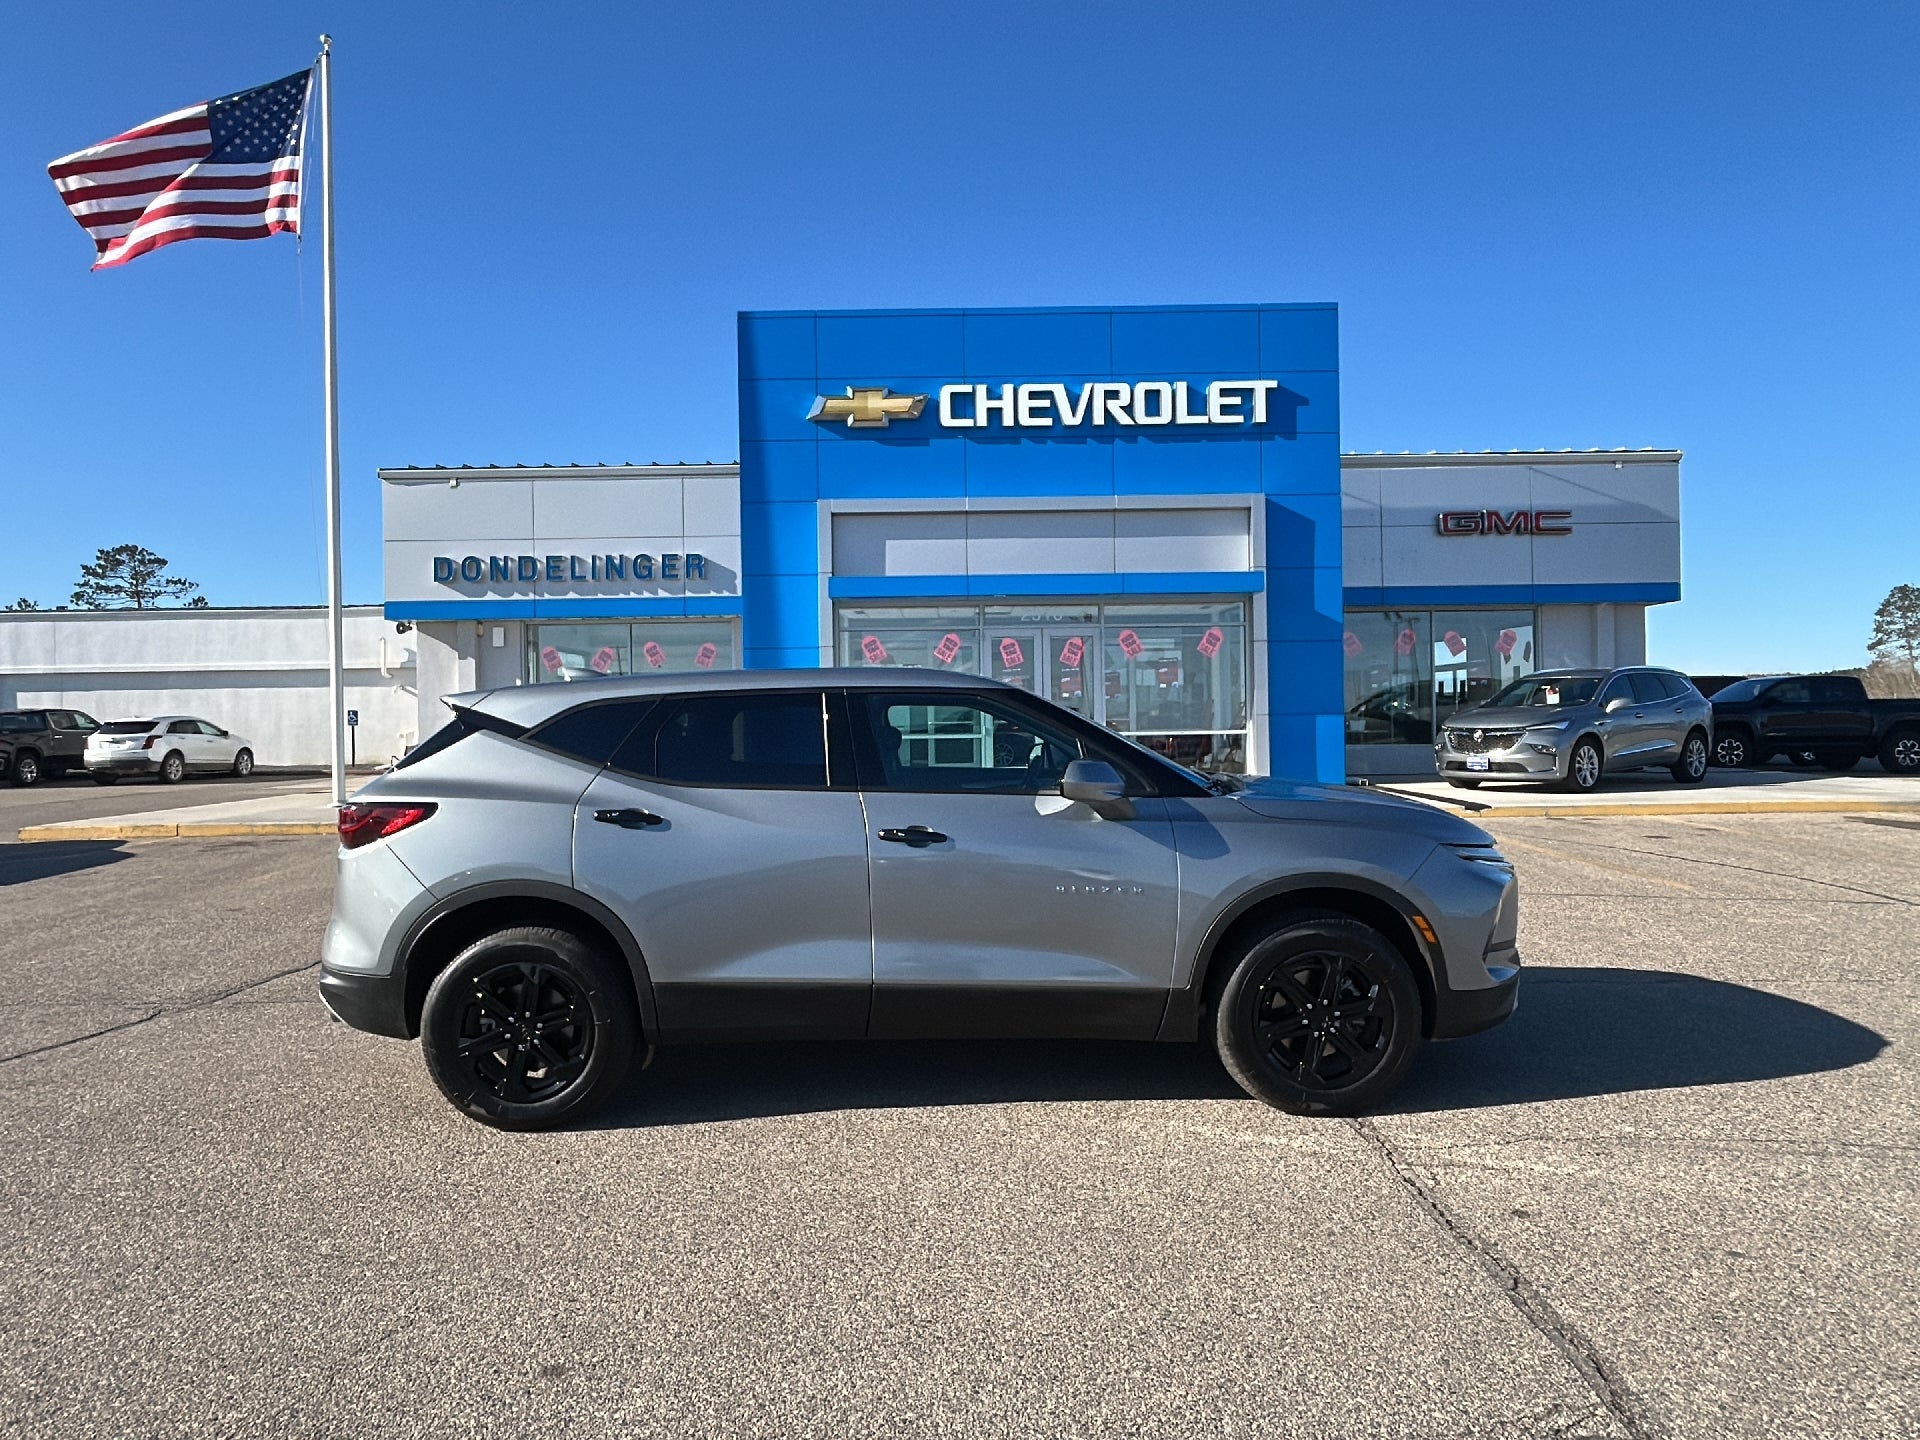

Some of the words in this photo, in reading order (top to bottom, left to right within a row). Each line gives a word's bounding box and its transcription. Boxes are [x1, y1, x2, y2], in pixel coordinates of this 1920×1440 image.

[940, 380, 1278, 427] CHEVROLET
[1438, 510, 1573, 535] GMC
[434, 553, 705, 582] DONDELINGER
